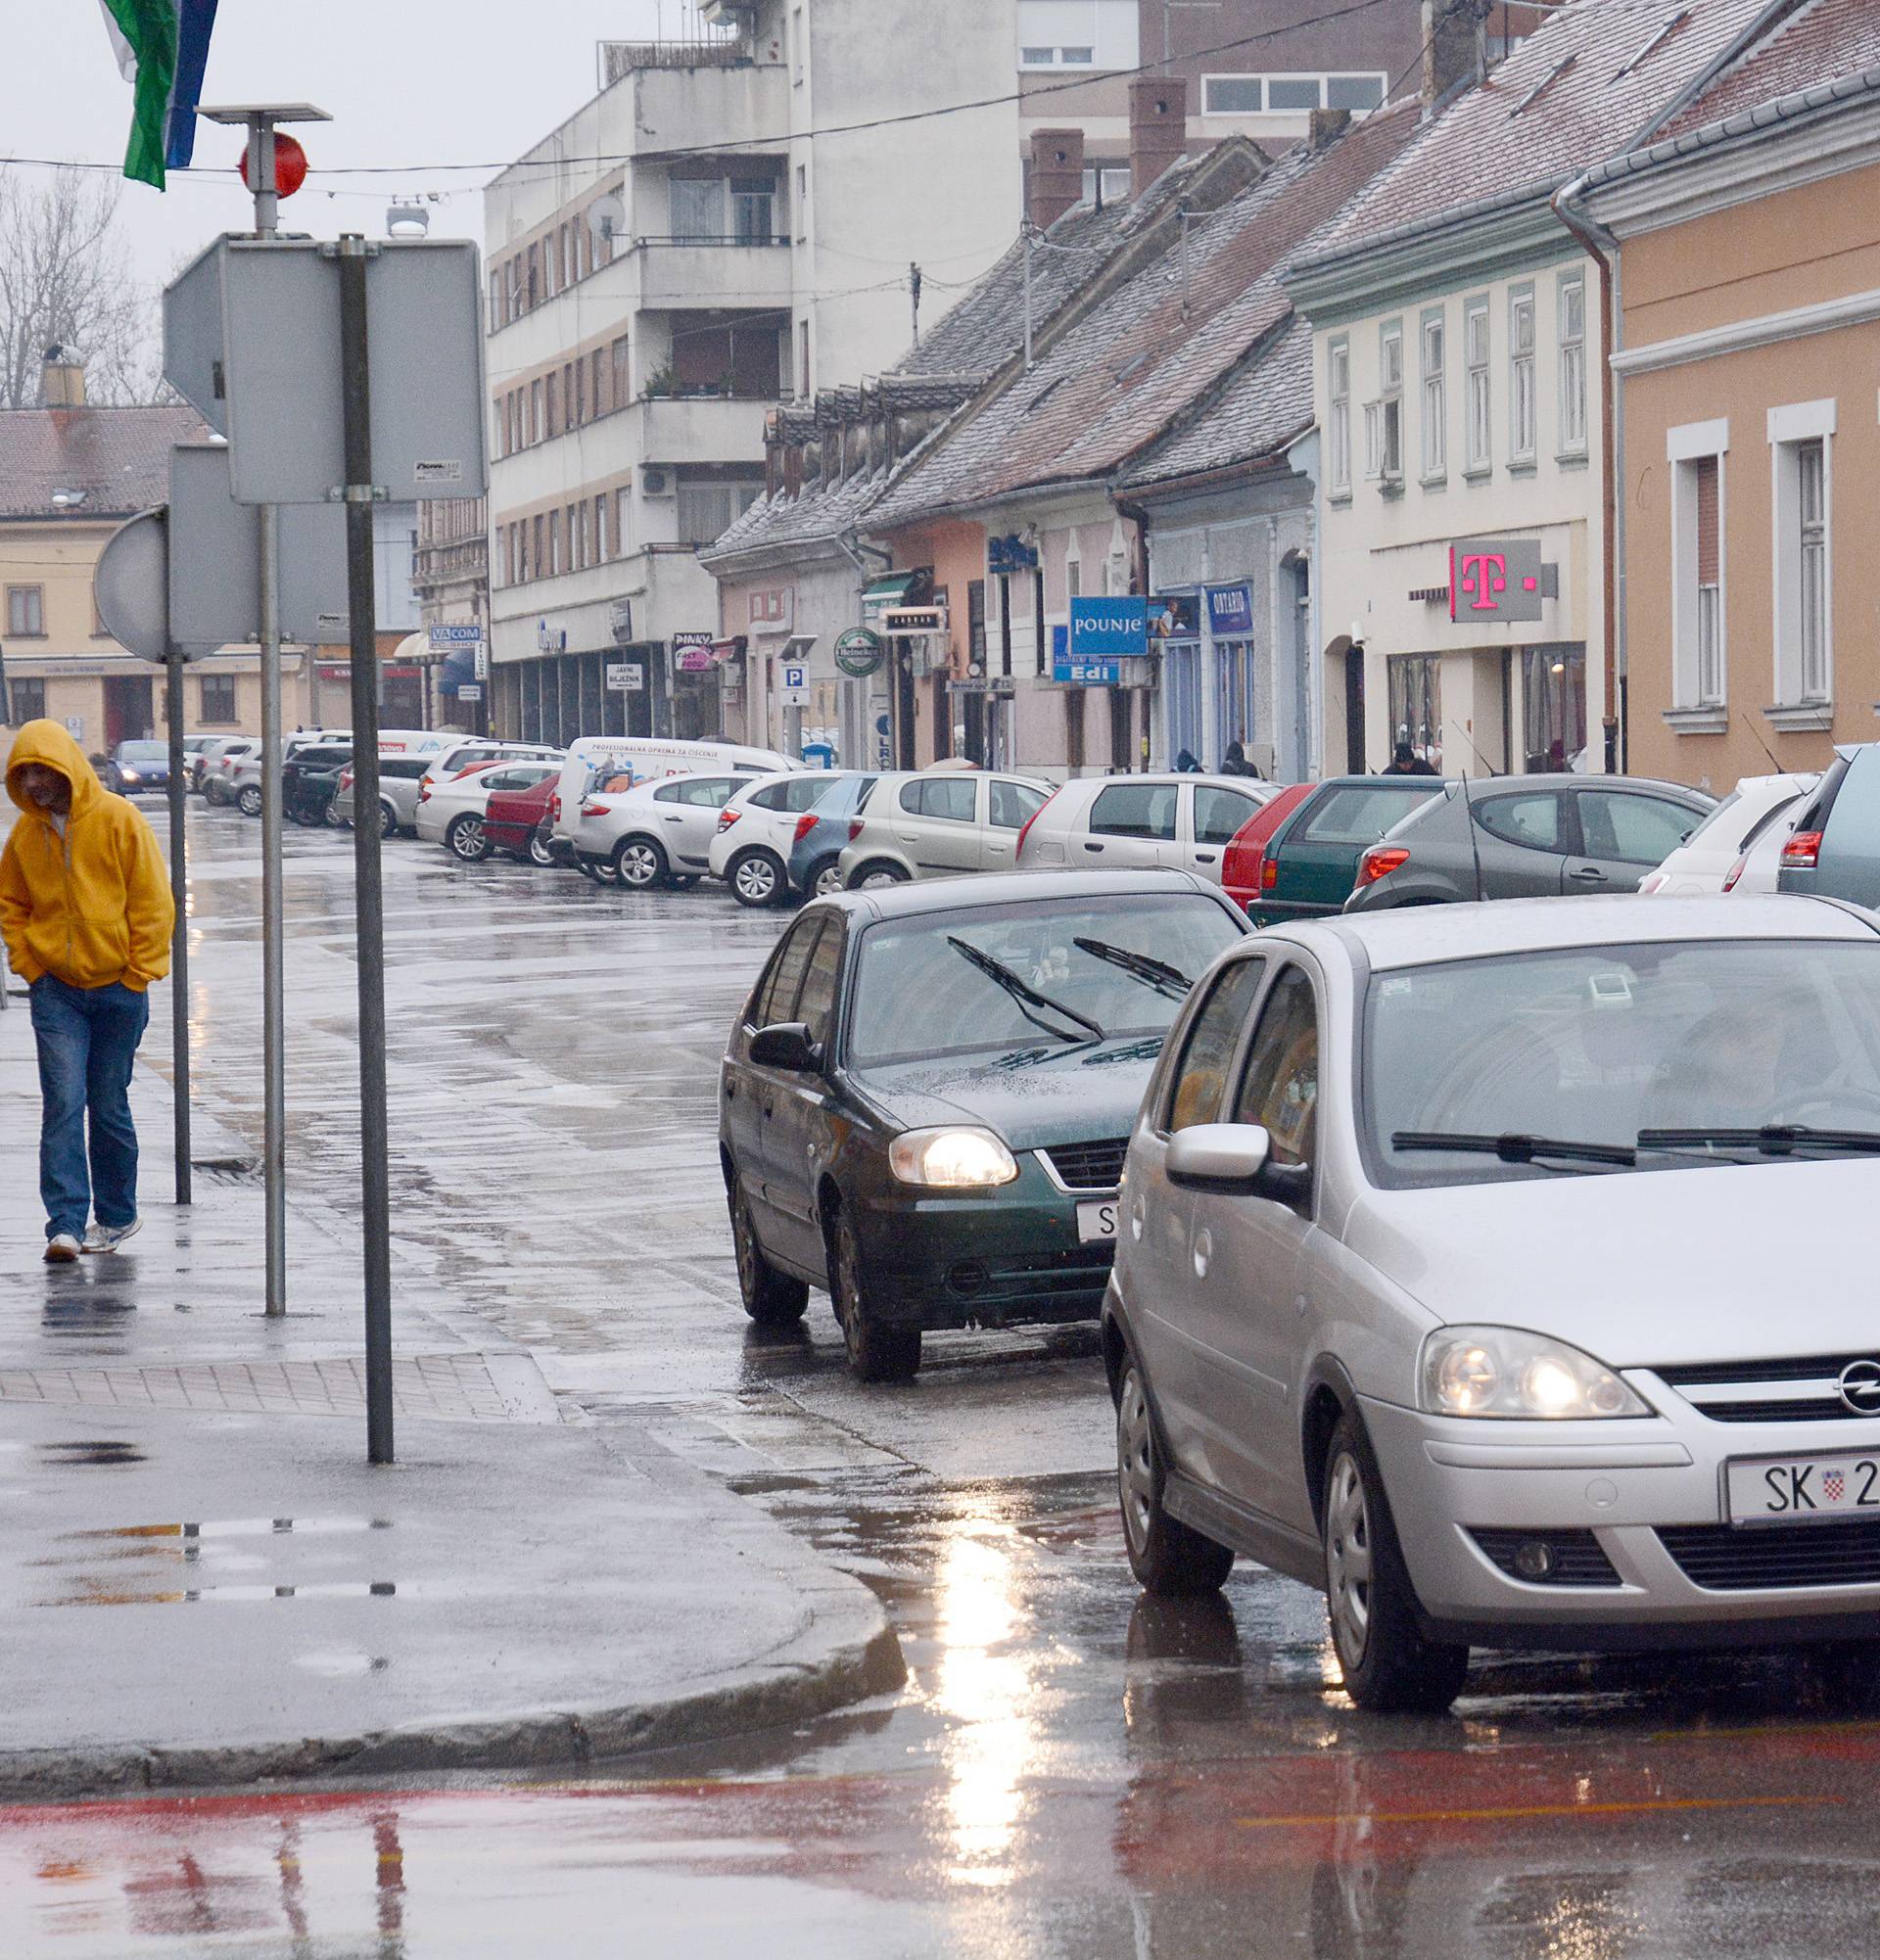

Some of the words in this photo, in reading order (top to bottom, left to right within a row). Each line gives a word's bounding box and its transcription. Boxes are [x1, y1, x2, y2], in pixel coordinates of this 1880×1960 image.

[433, 629, 479, 640] VACOM
[675, 633, 710, 645] PINKY
[1071, 666, 1108, 679] Edi
[1765, 1466, 1816, 1511] SK
[1855, 1460, 1880, 1506] 2
